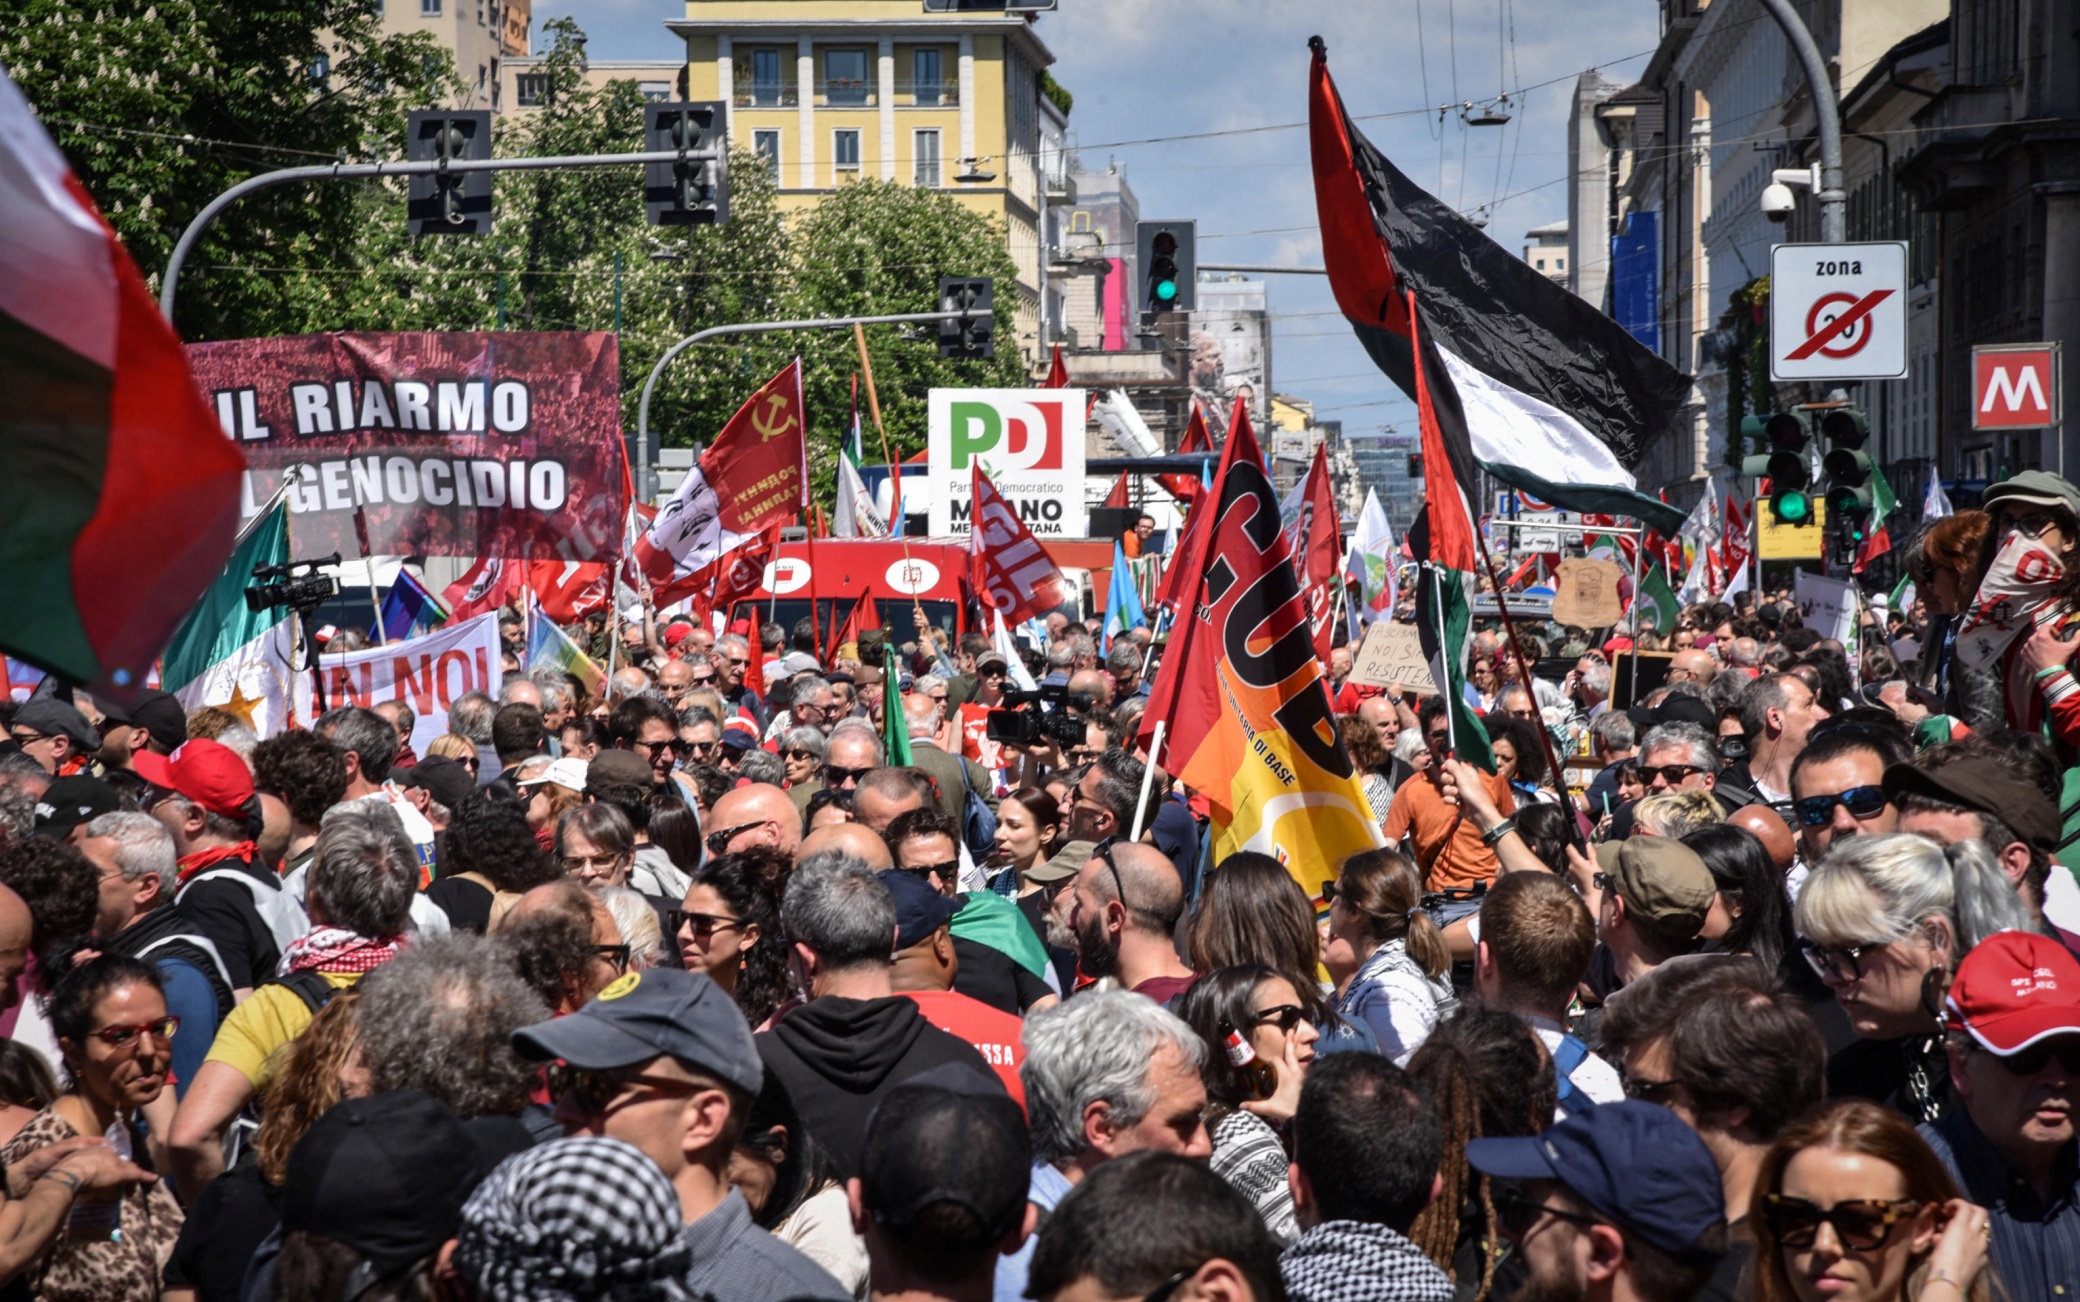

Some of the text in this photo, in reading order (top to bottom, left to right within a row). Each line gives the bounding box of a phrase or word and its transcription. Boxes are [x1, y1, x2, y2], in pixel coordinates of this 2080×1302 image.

[1816, 260, 1862, 276] zona
[1980, 365, 2048, 413] M
[217, 382, 529, 440] IL RIARMO
[951, 402, 1063, 469] PD
[282, 456, 565, 512] GENOCIDIO
[950, 481, 1063, 493] Part Democratico
[951, 499, 1063, 521] MNO
[1369, 624, 1417, 640] FASCISM
[1372, 643, 1423, 661] NOI SIA
[393, 646, 489, 716] NOI
[1365, 661, 1434, 685] RESISTEN
[1228, 691, 1256, 743] UNITARIA
[1253, 738, 1268, 757] DI
[1263, 752, 1297, 787] BASE
[974, 1043, 1014, 1066] SSA
